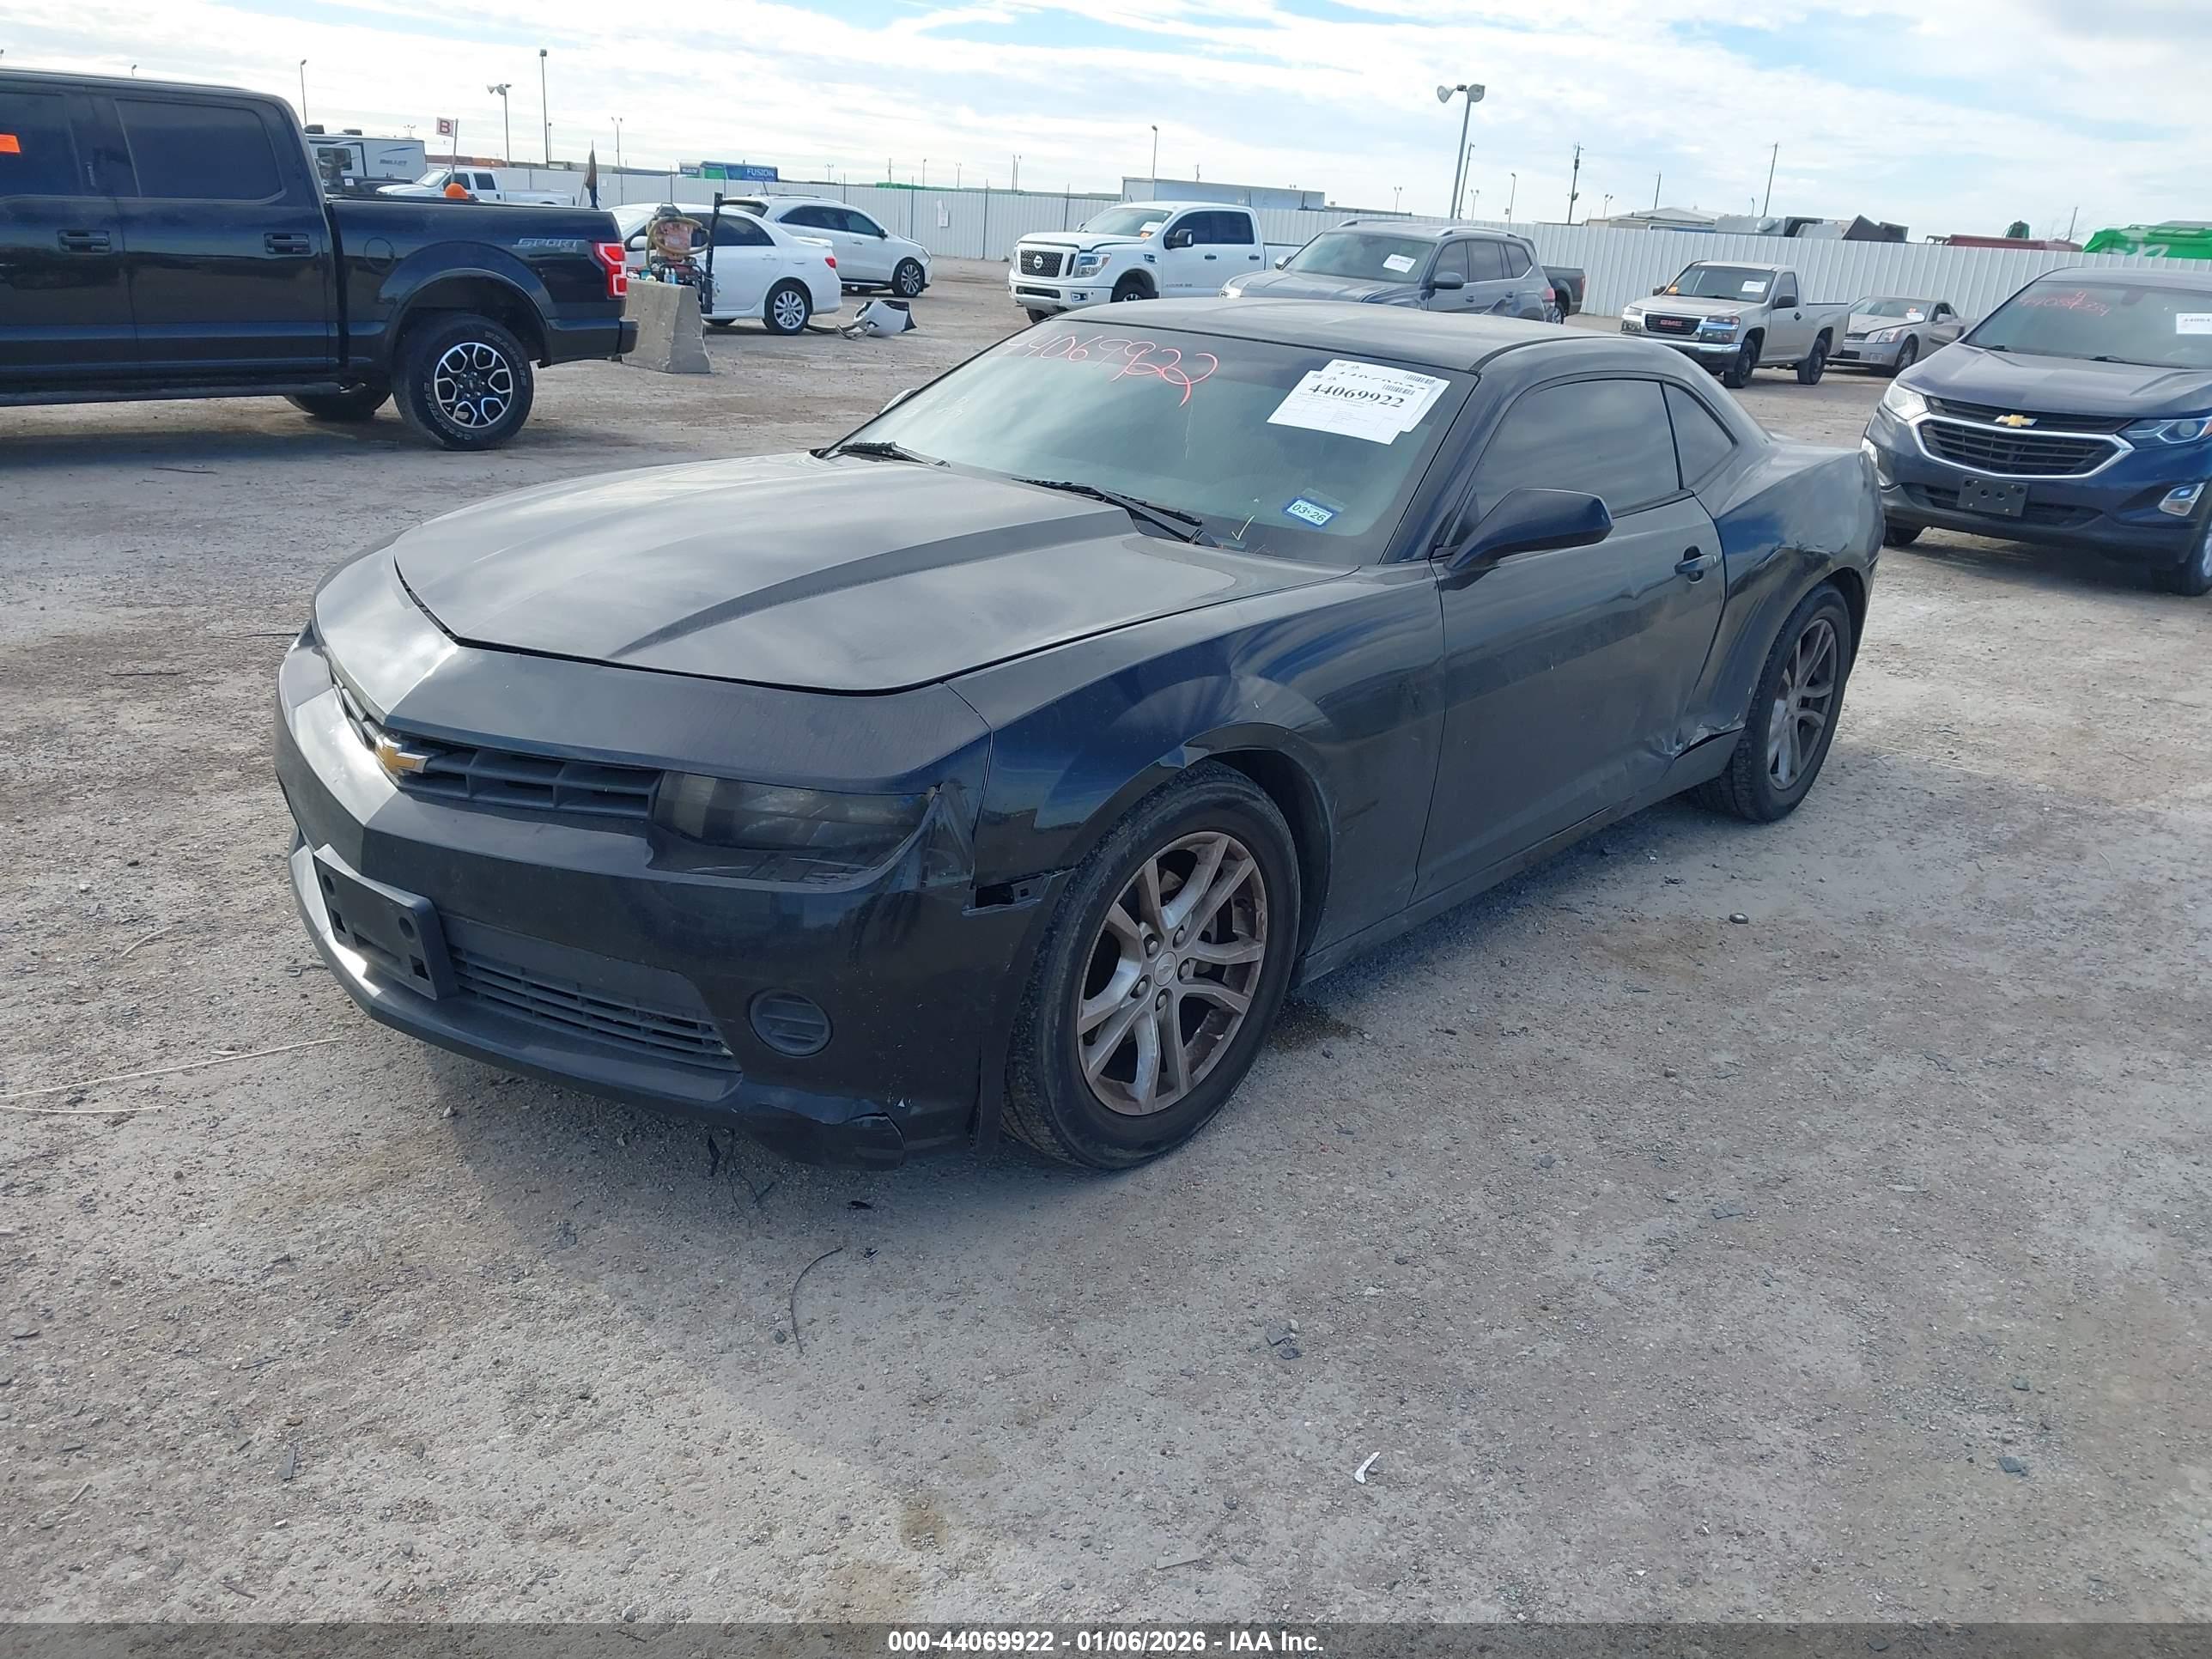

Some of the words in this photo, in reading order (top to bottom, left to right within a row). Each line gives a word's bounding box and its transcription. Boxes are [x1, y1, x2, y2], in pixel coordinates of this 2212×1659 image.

[439, 120, 451, 134] B
[746, 167, 775, 177] FUSION
[1002, 335, 1218, 408] 44069922
[1308, 383, 1405, 409] 44069922
[1292, 504, 1308, 514] 03
[1310, 511, 1327, 522] 26
